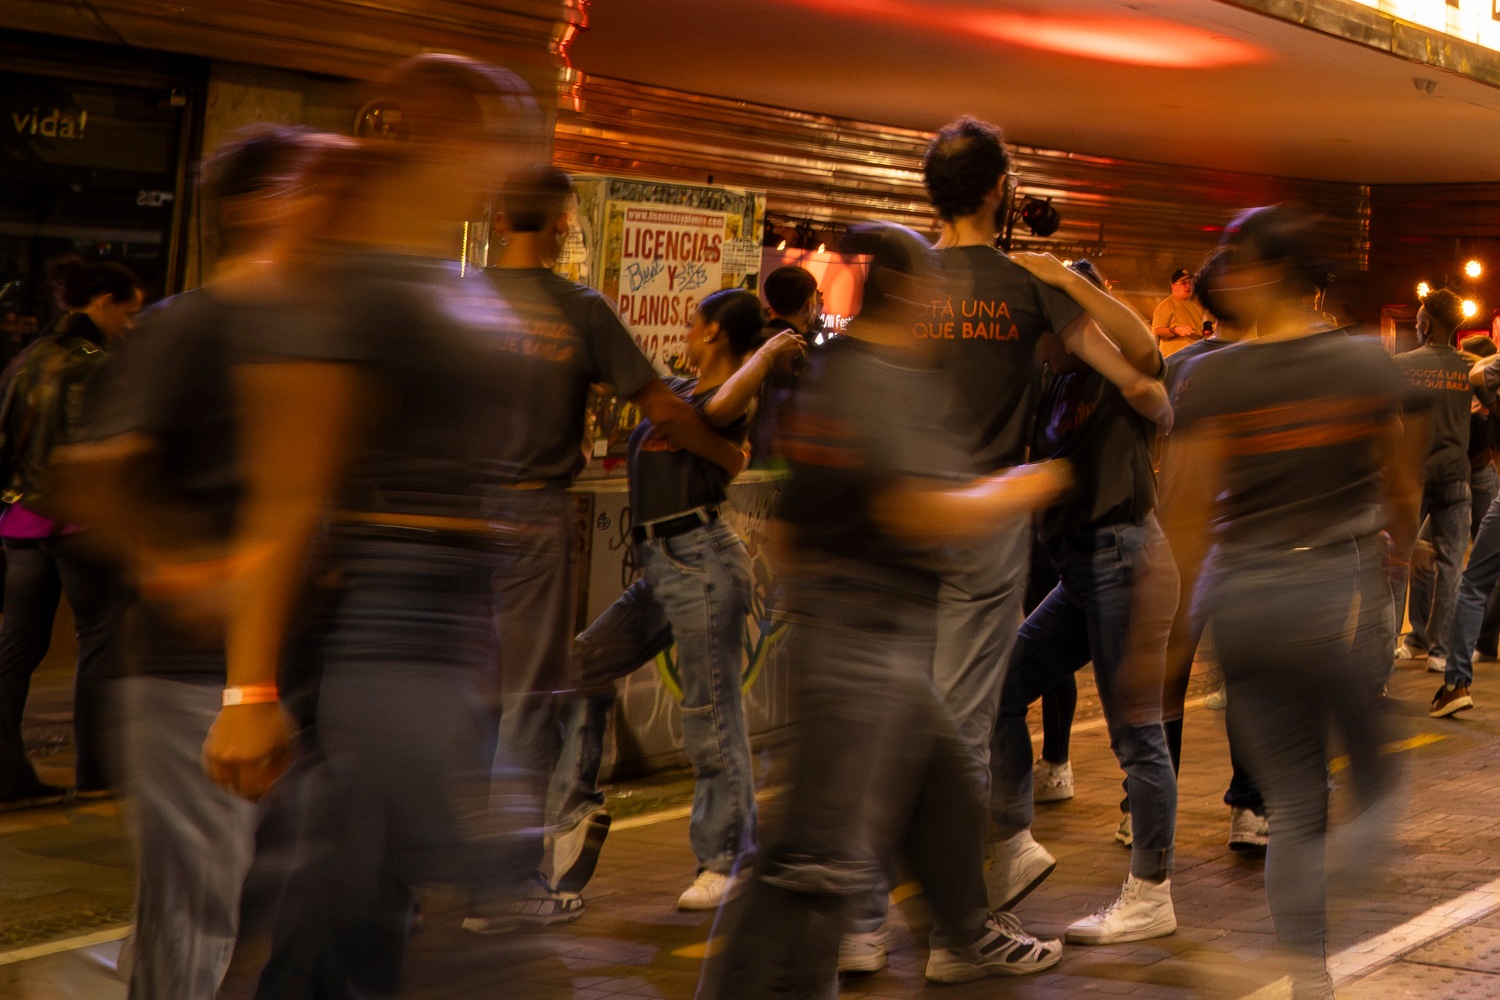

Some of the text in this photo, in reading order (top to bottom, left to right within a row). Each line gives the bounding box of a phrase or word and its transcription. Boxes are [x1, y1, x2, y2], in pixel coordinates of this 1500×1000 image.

[13, 107, 88, 140] vida!
[624, 227, 722, 263] LICENCIAS
[667, 265, 677, 292] Y
[961, 300, 1011, 319] UNA
[912, 321, 1020, 341] QUE BAILA
